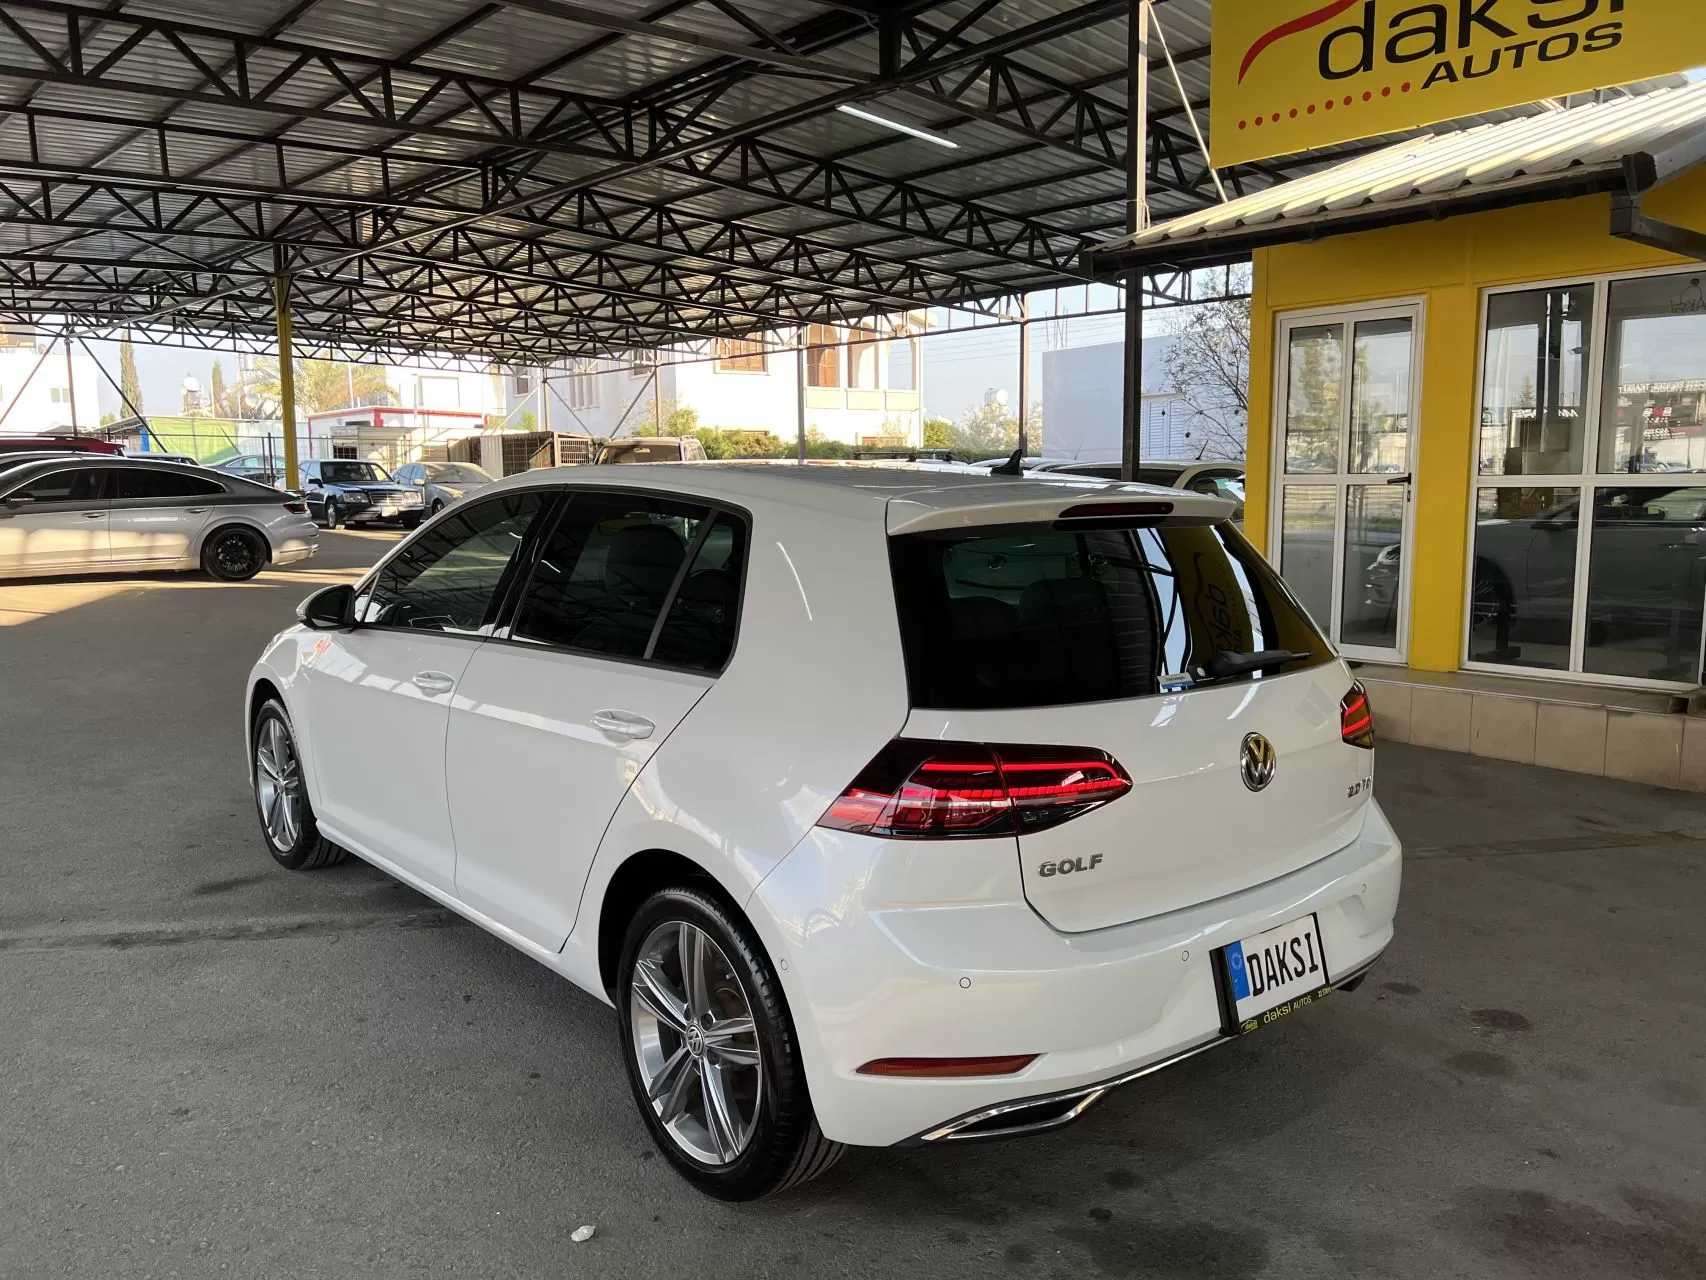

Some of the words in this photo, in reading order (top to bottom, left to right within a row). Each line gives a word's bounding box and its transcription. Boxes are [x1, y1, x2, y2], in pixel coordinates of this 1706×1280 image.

[1420, 21, 1624, 90] AUTOS
[1038, 853, 1103, 878] GOLF
[1246, 932, 1319, 997] DAKSI
[1263, 1002, 1292, 1024] daksi
[1293, 995, 1312, 1010] AUTOS
